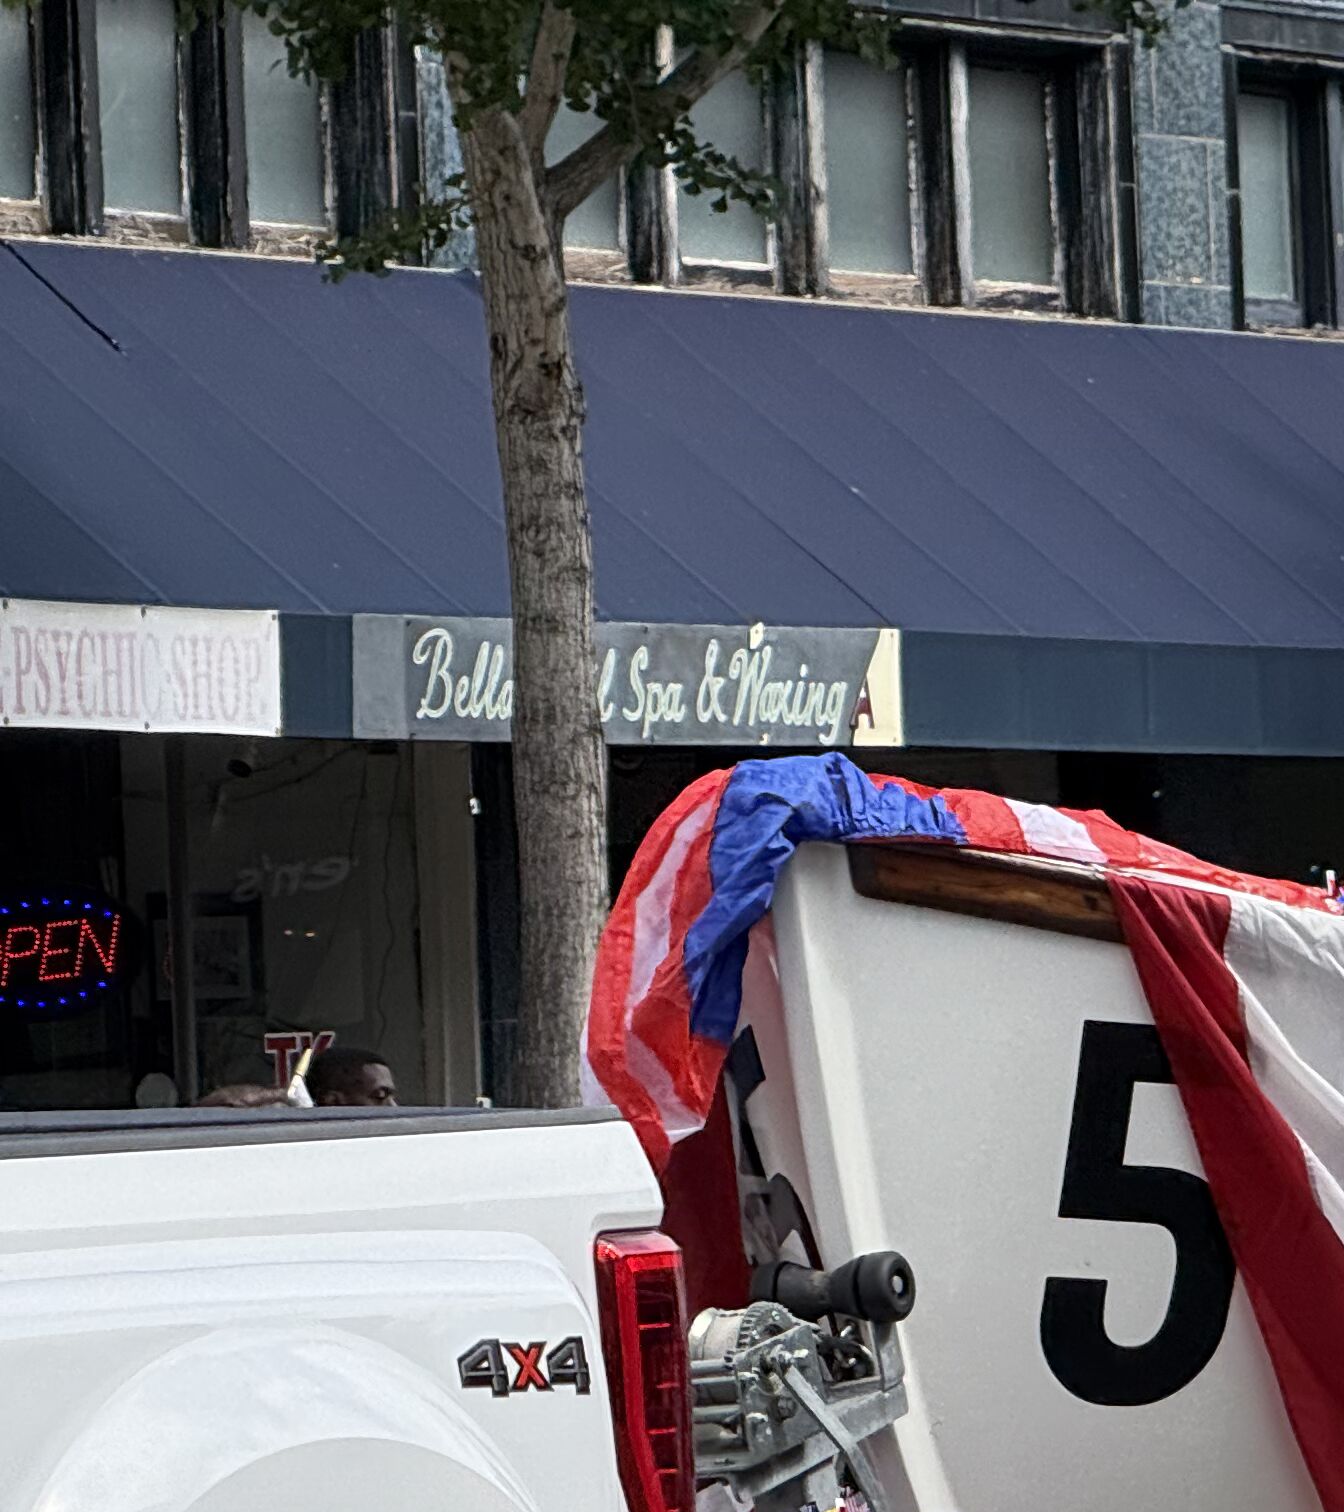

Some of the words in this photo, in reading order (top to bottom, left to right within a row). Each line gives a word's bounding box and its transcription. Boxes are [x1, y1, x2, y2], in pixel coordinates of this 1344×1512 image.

[11, 626, 160, 718] PSYCHIC
[624, 645, 685, 740] Spa
[698, 640, 725, 726] &
[729, 645, 847, 745] Waxing
[0, 914, 120, 986] PEN
[1040, 1020, 1239, 1406] 5
